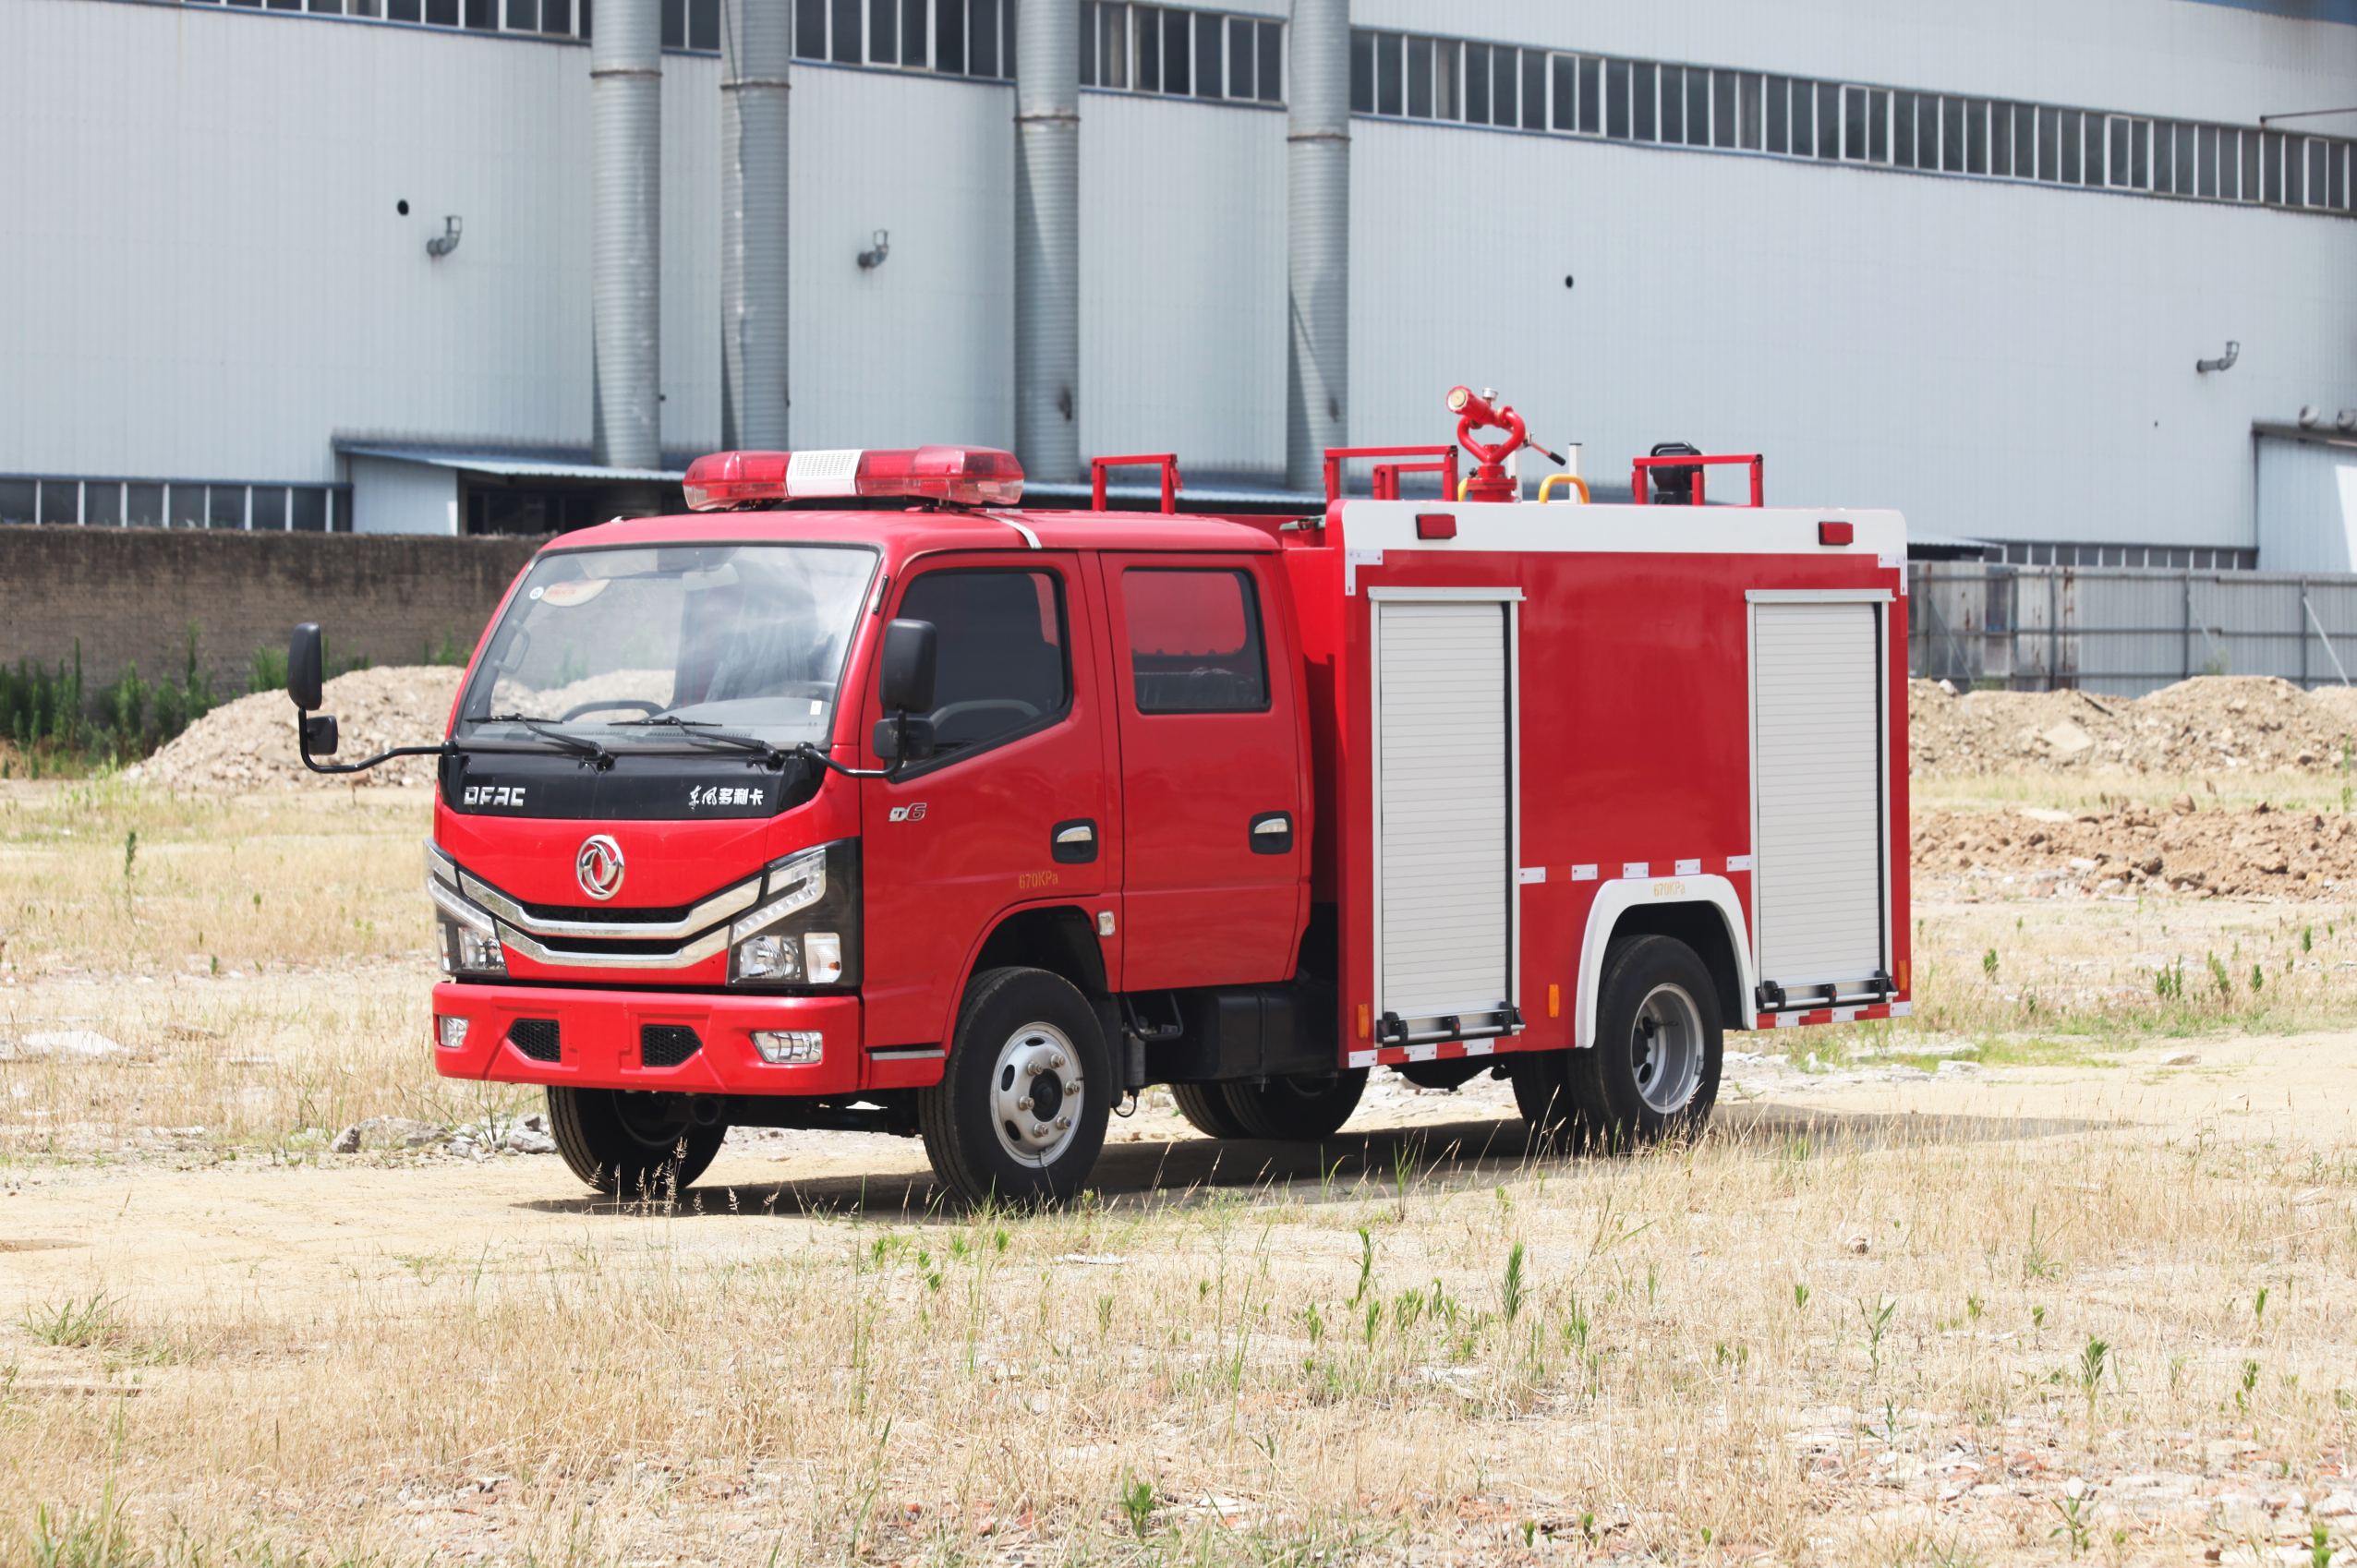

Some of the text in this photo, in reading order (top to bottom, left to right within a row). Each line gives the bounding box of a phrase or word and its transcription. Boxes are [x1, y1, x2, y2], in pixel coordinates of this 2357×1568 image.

[464, 786, 526, 806] DFAC
[688, 785, 764, 811] 东风多利卡
[1019, 871, 1058, 889] 670KPa
[1653, 881, 1686, 897] 670KPa
